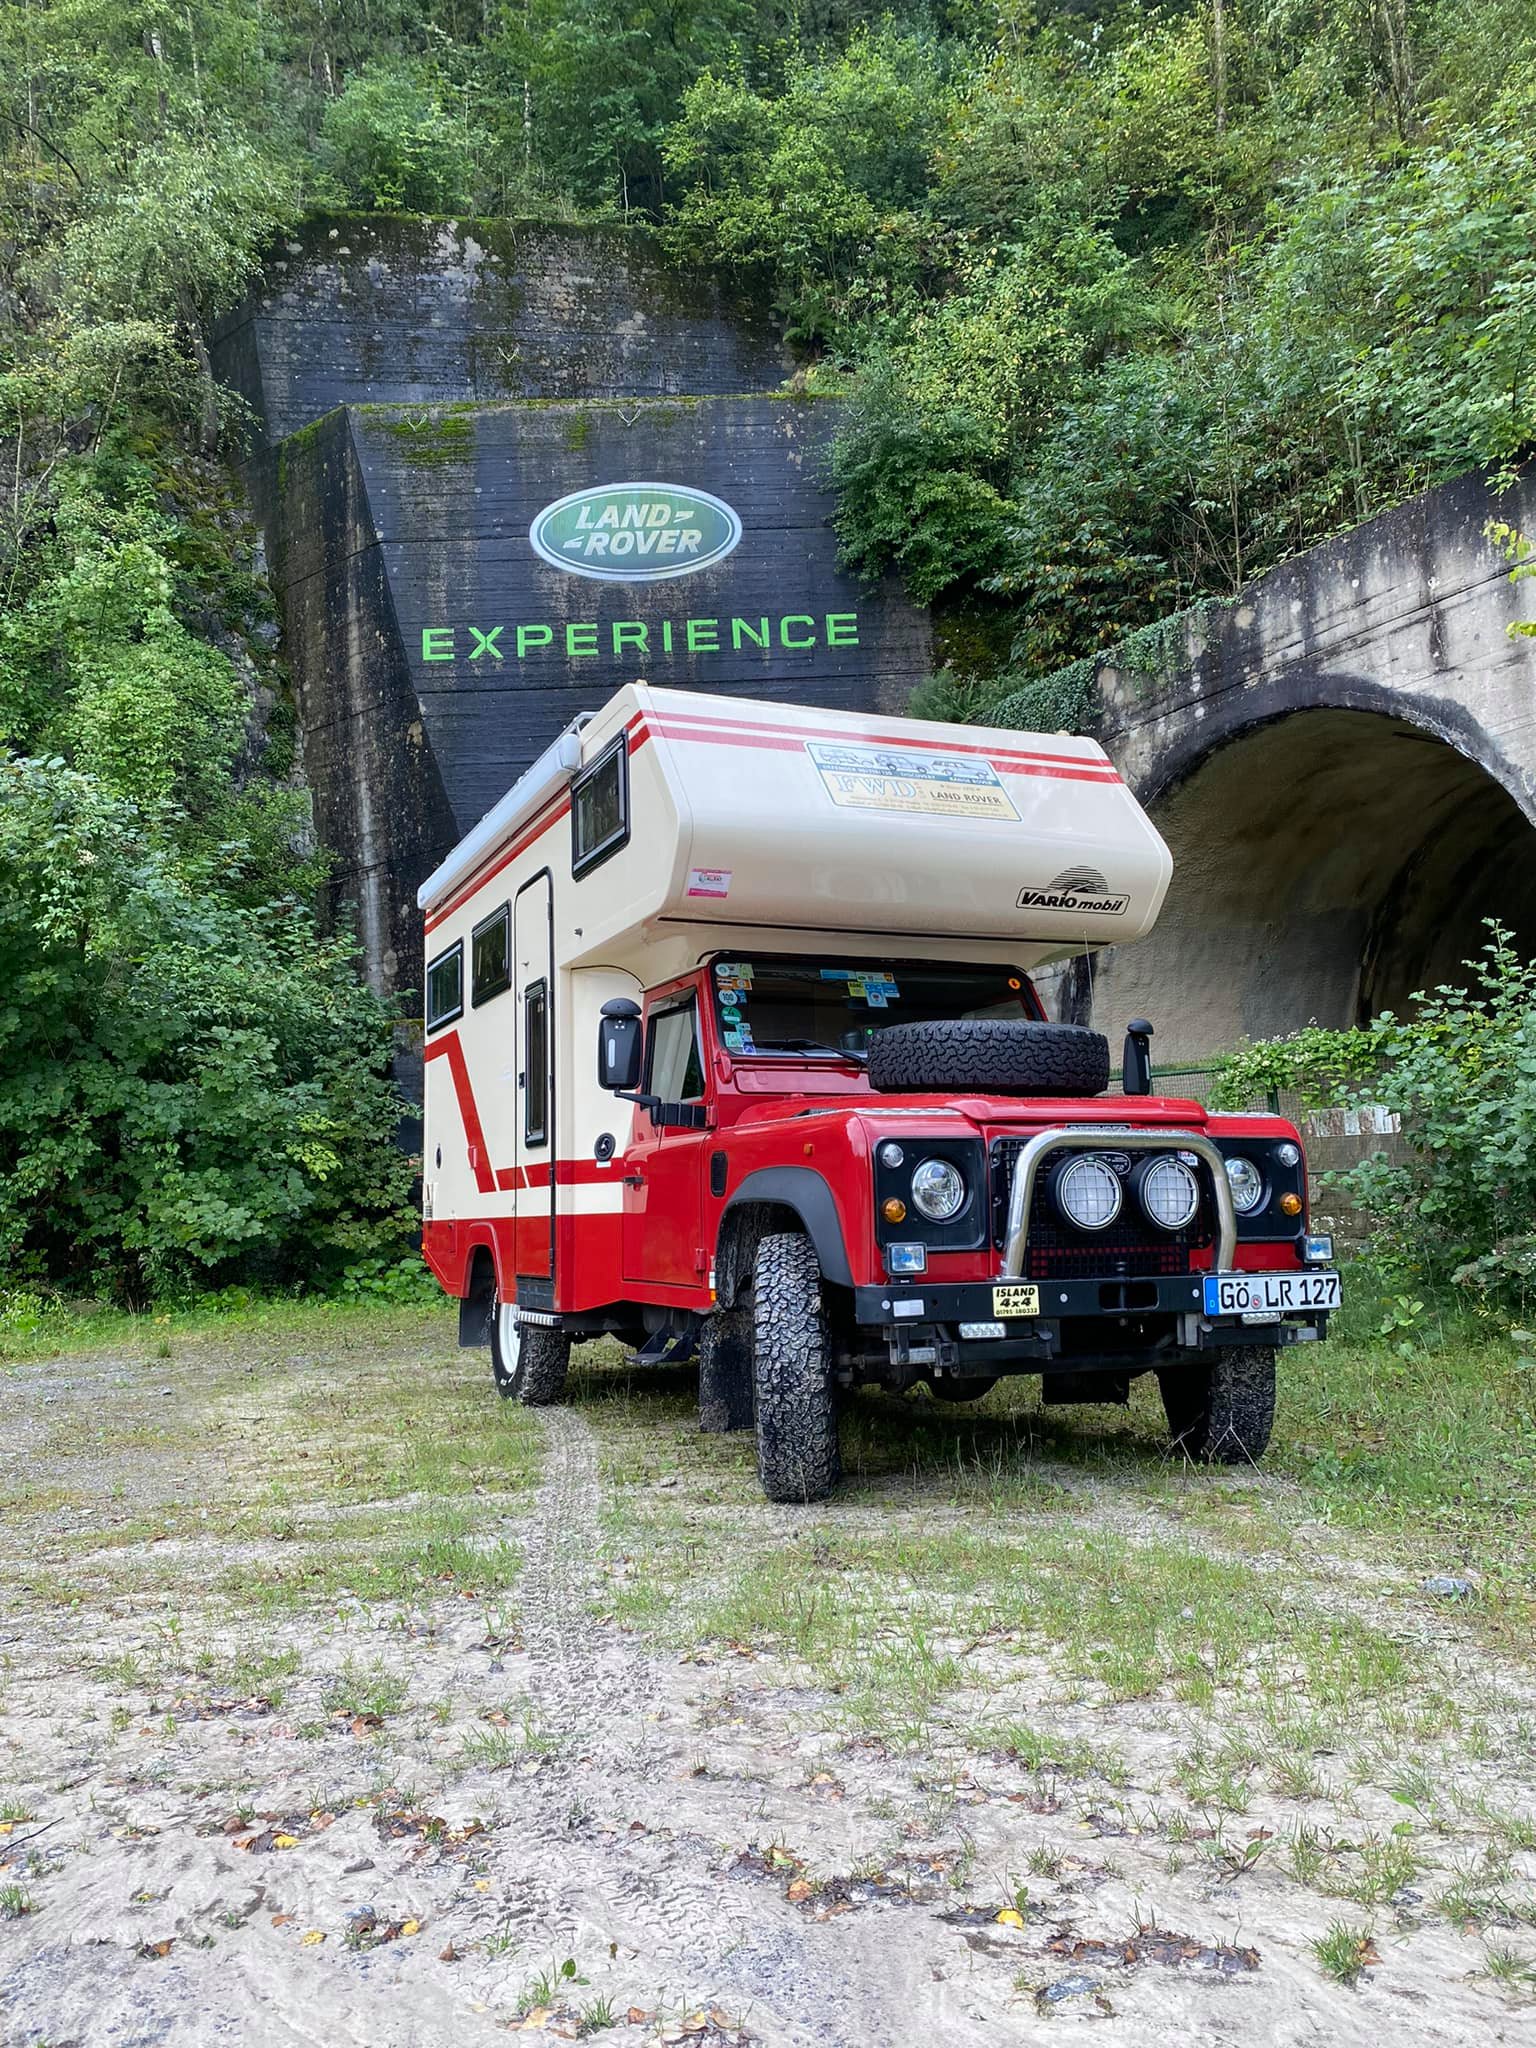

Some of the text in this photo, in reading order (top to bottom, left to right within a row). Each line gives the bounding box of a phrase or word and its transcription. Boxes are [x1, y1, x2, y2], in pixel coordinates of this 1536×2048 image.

[575, 503, 673, 530] LAND
[583, 529, 702, 557] ROVER
[422, 613, 860, 662] EXPERIENCE
[836, 775, 915, 798] FWD
[929, 791, 961, 801] LAND
[964, 794, 1001, 804] ROVER
[1021, 892, 1123, 912] VARIO mobil
[996, 1287, 1036, 1298] ISLAND
[1000, 1297, 1032, 1308] 4x4
[1220, 1281, 1250, 1309] GÖ
[1264, 1280, 1294, 1307] LR
[1299, 1278, 1337, 1306] 127
